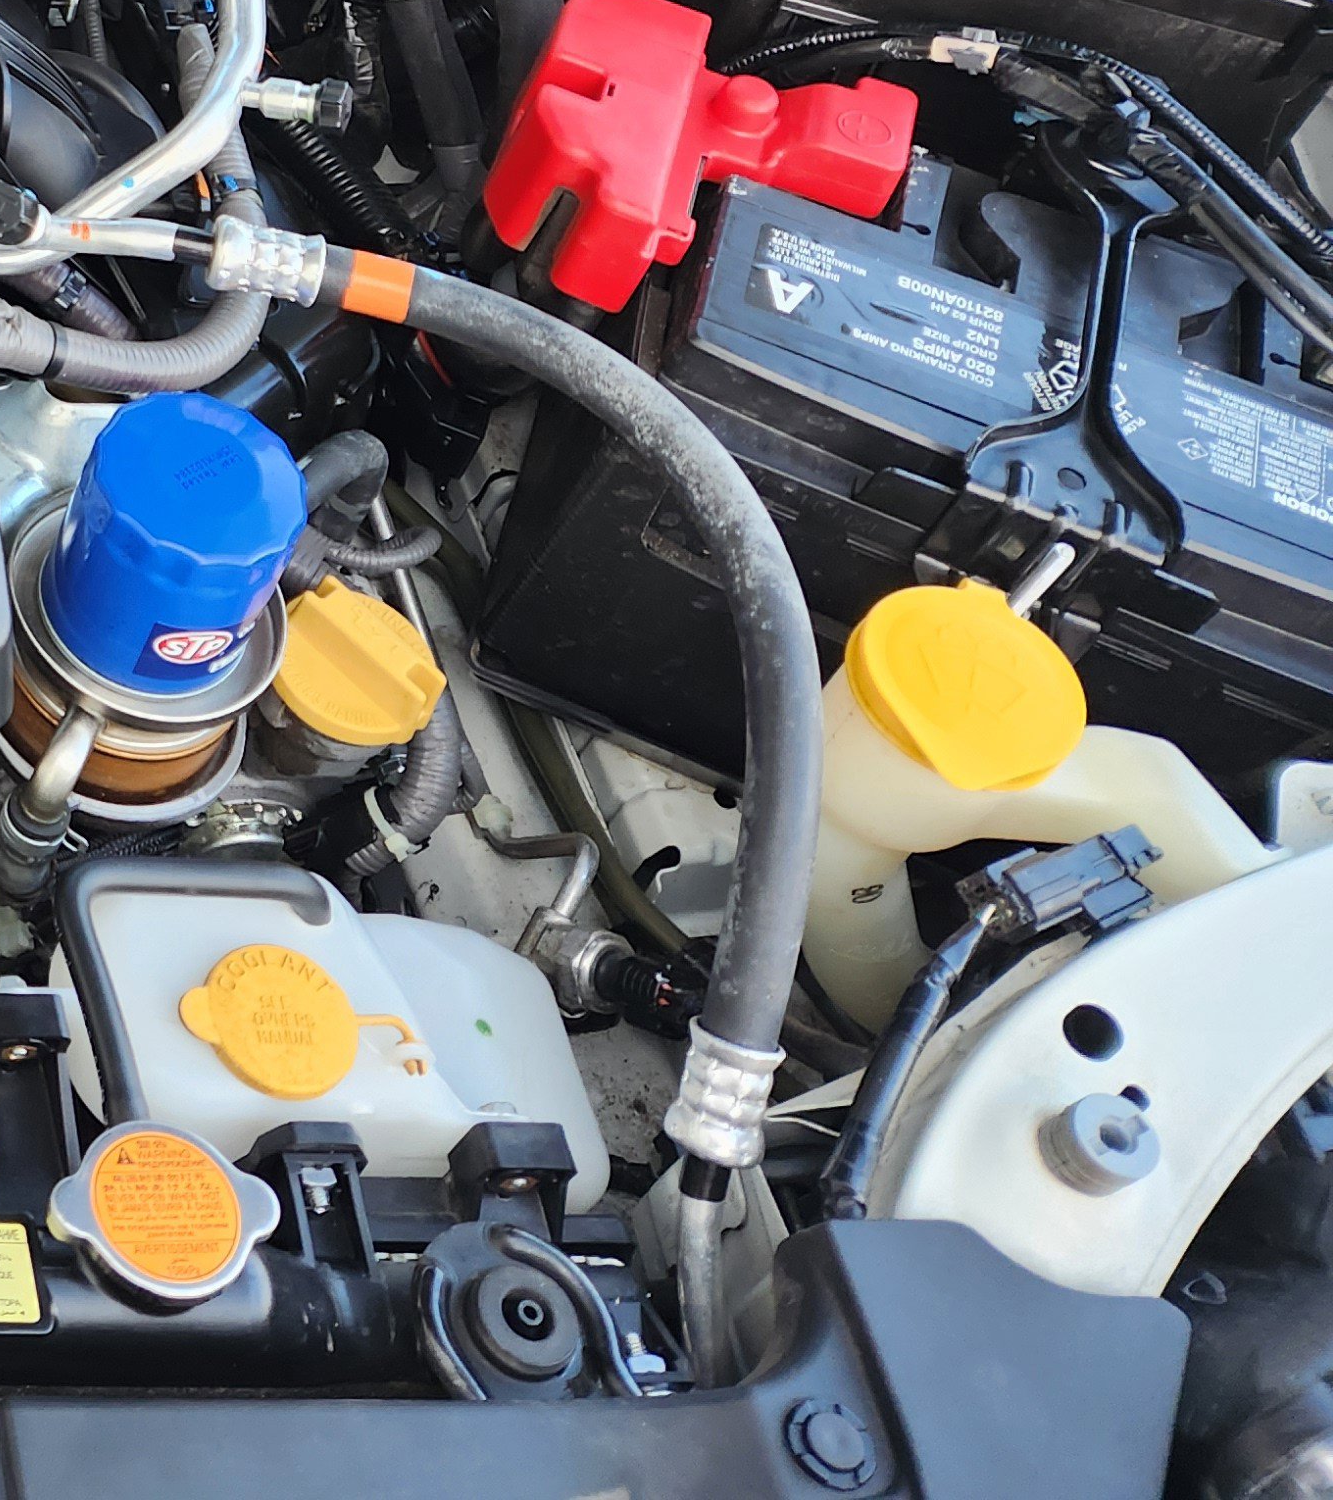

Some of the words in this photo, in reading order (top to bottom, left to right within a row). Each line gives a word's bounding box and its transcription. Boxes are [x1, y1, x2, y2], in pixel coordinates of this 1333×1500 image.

[799, 238, 809, 248] IN
[810, 241, 836, 257] MADE
[783, 255, 840, 283] DISTRIBUTED
[897, 275, 1005, 322] 82110AN00B
[930, 301, 949, 316] AH
[951, 307, 968, 323] 62
[968, 314, 1003, 335] 20HR
[852, 327, 889, 351] AMPS
[922, 326, 950, 344] SIZE
[966, 328, 1000, 350] LN2
[912, 336, 963, 365] AMPS
[951, 340, 999, 362] GROUP
[892, 346, 957, 378] CRANKING
[965, 356, 997, 376] 620
[957, 366, 994, 389] COLD
[162, 634, 227, 663] STP
[217, 950, 335, 992] COOLANT
